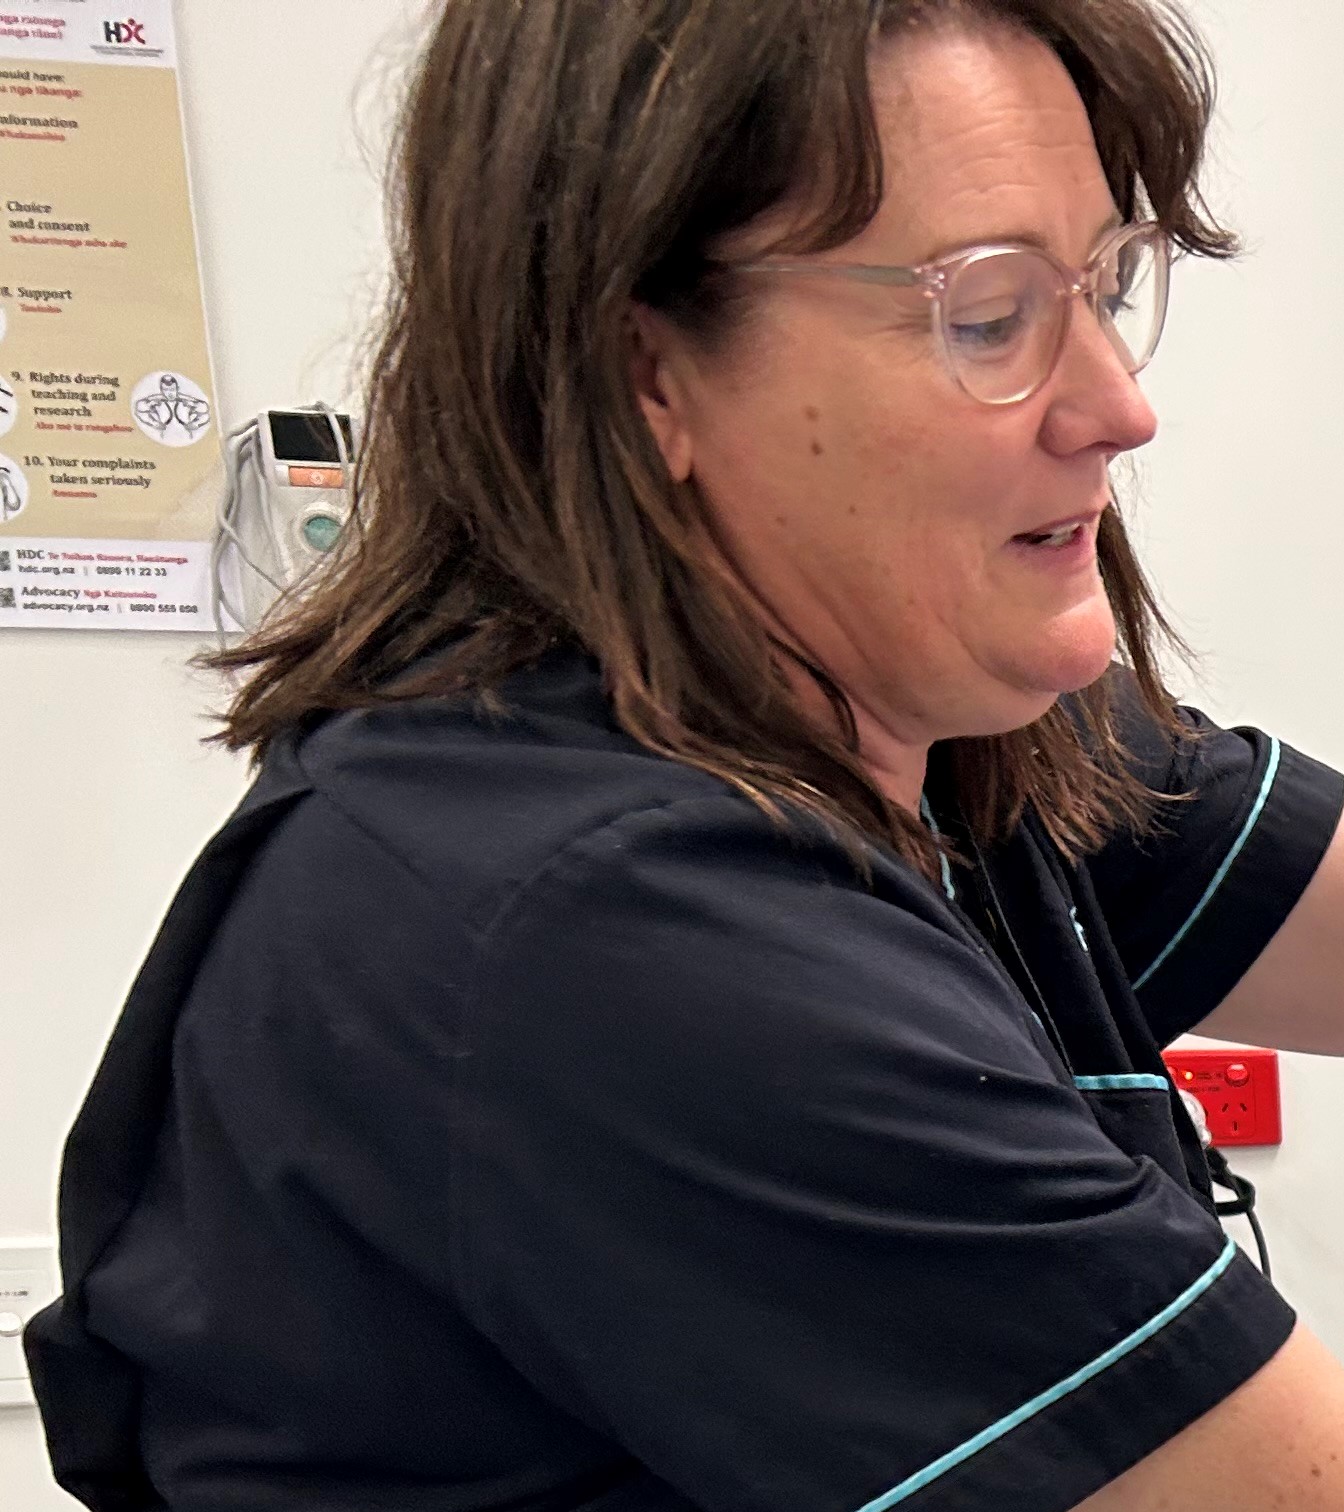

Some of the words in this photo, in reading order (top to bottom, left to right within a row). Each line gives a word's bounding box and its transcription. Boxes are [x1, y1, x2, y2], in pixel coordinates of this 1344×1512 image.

[0, 115, 78, 129] nformation
[7, 201, 52, 214] Choice
[9, 219, 35, 231] and
[38, 221, 91, 233] consent
[17, 286, 72, 301] Support
[29, 372, 72, 386] Rights
[74, 373, 120, 387] during
[31, 388, 90, 403] teaching
[91, 391, 116, 402] and
[34, 405, 92, 418] research
[23, 456, 44, 467] 10.
[48, 457, 78, 468] Your
[82, 458, 157, 471] complaints
[50, 474, 89, 485] taken
[91, 476, 151, 489] seriously
[17, 549, 45, 561] HDC
[21, 587, 81, 600] Advocacy
